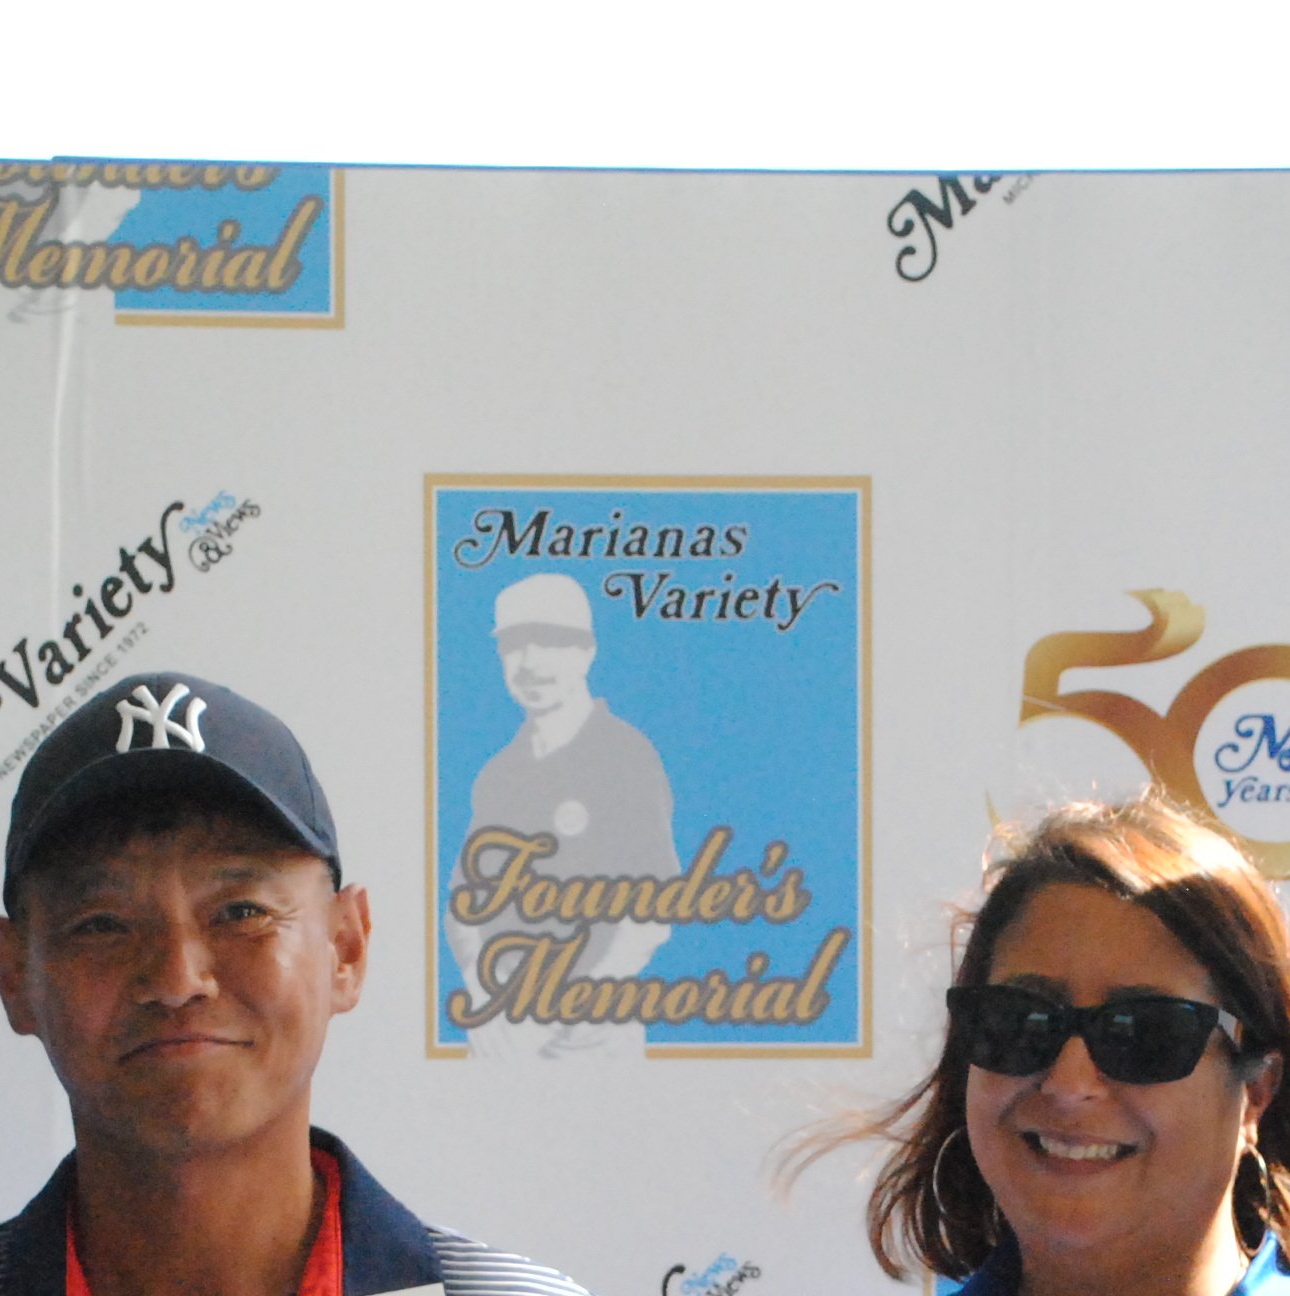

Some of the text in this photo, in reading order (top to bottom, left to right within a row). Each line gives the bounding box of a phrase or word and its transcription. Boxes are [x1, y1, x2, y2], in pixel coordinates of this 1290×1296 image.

[454, 509, 749, 569] Marianas
[603, 571, 840, 632] Variety
[75, 654, 118, 697] SINCE
[117, 622, 149, 653] 1972
[450, 825, 811, 925] Founder's
[446, 924, 851, 1029] Memorial
